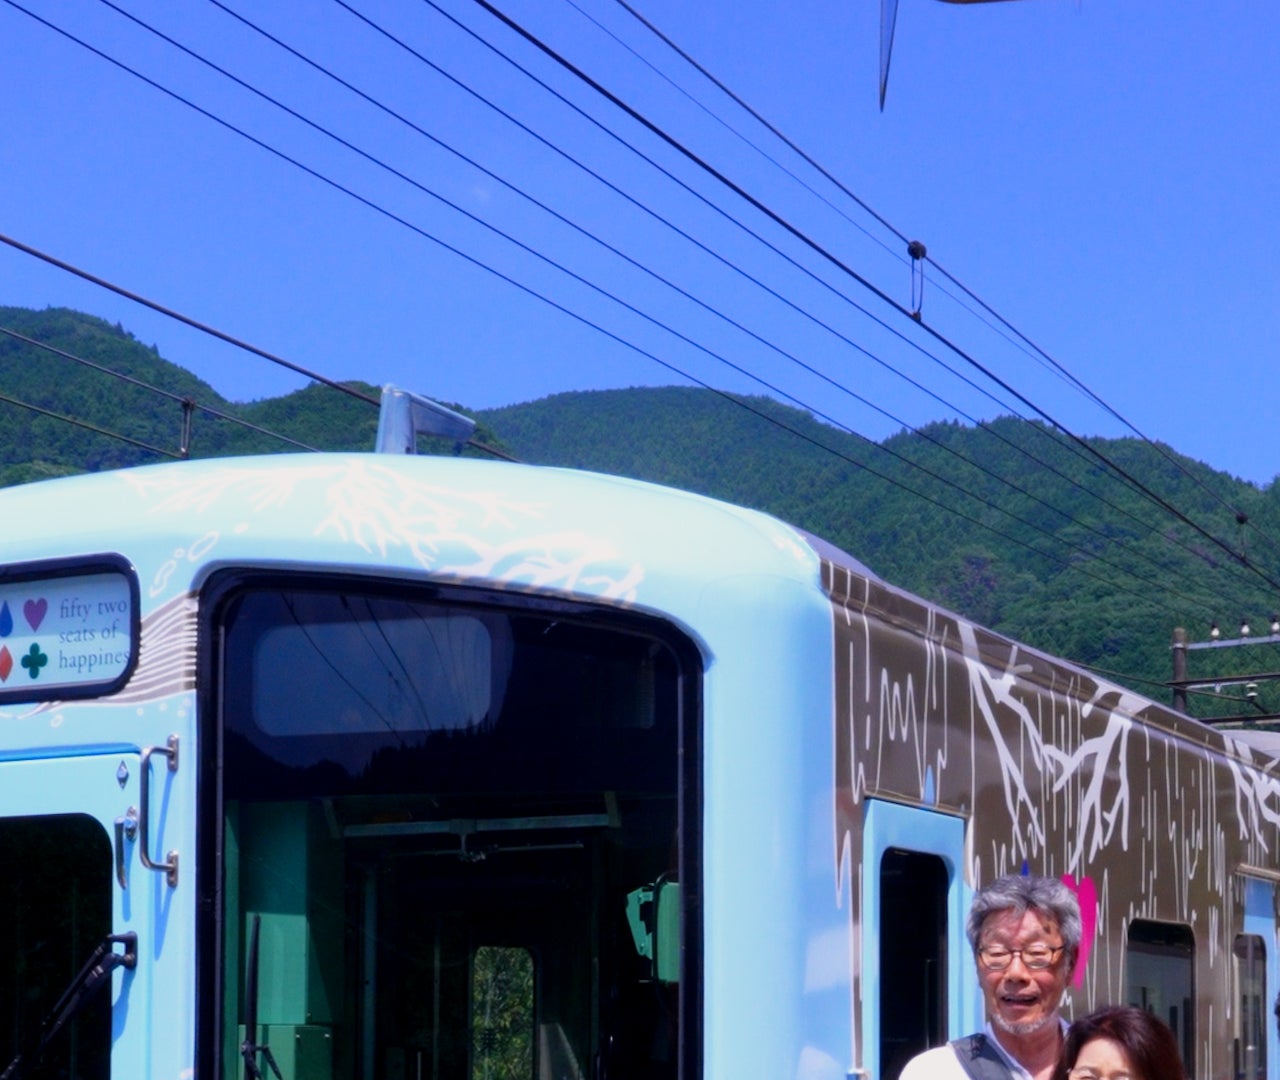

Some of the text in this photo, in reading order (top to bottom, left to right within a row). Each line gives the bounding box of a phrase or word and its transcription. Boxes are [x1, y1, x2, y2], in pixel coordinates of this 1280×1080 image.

[59, 598, 128, 619] fifty two
[58, 619, 120, 644] seats of
[58, 650, 130, 674] happines
